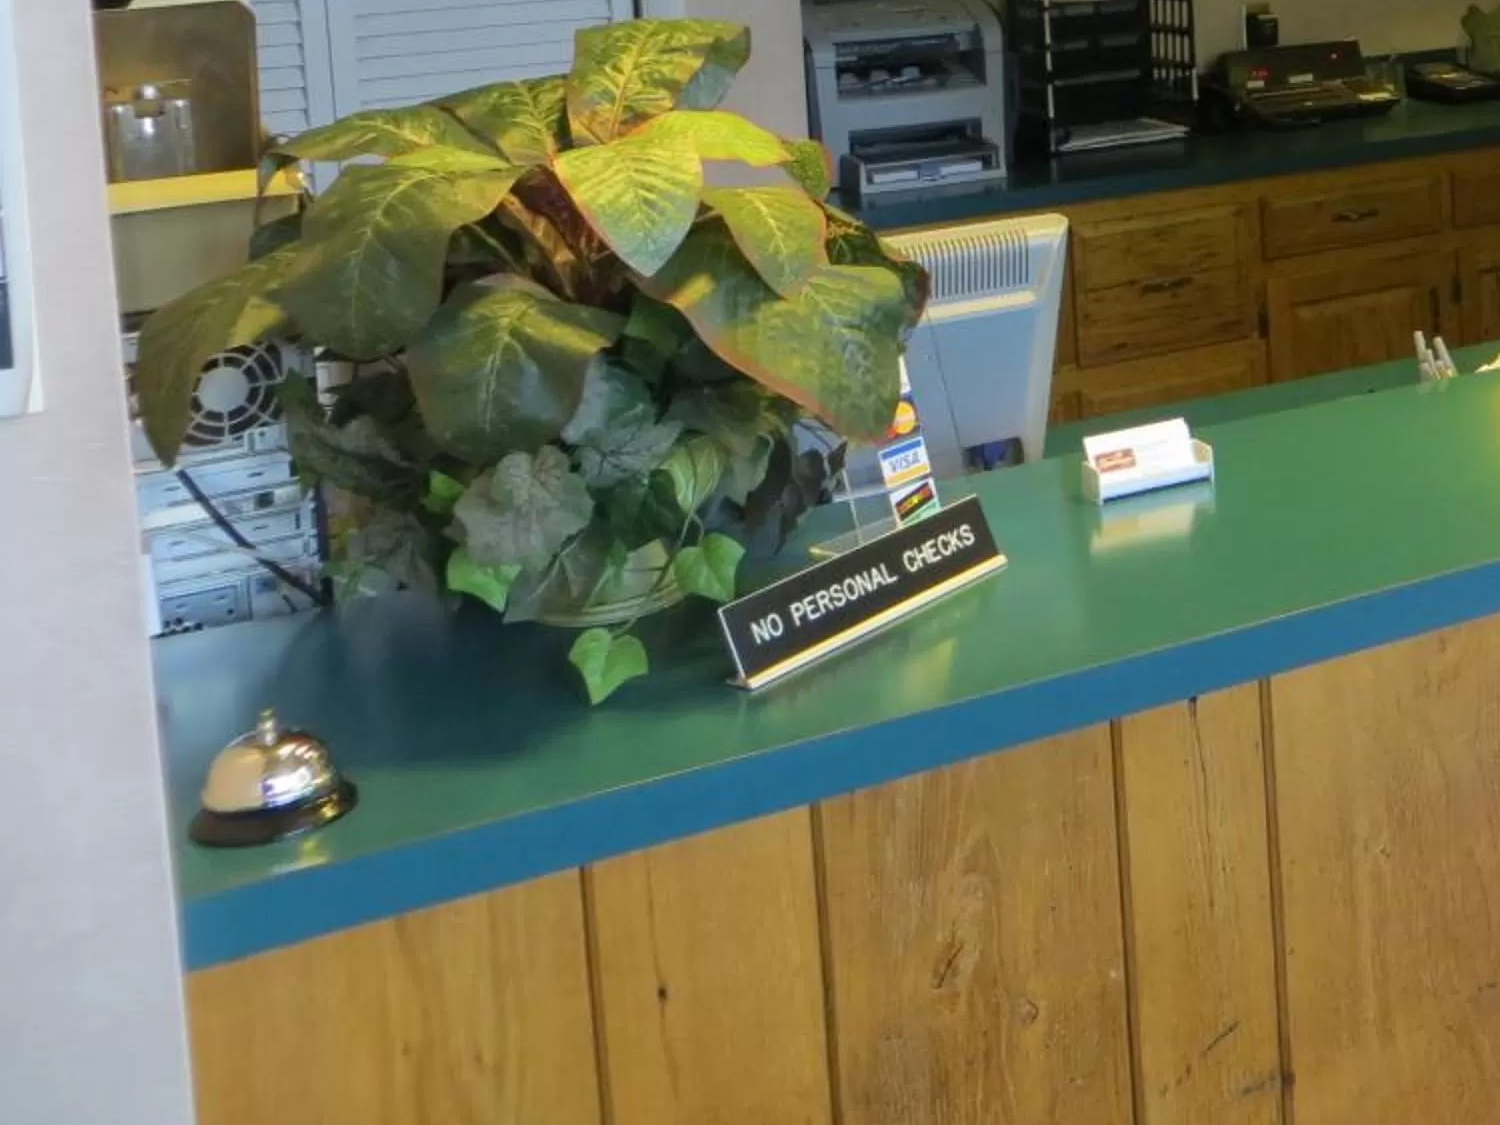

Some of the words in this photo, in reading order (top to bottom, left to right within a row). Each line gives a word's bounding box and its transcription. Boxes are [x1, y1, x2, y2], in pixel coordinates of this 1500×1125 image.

[888, 451, 921, 473] VISA
[750, 613, 784, 645] NO
[789, 562, 898, 628] PERSONAL
[902, 523, 976, 573] CHECKS
